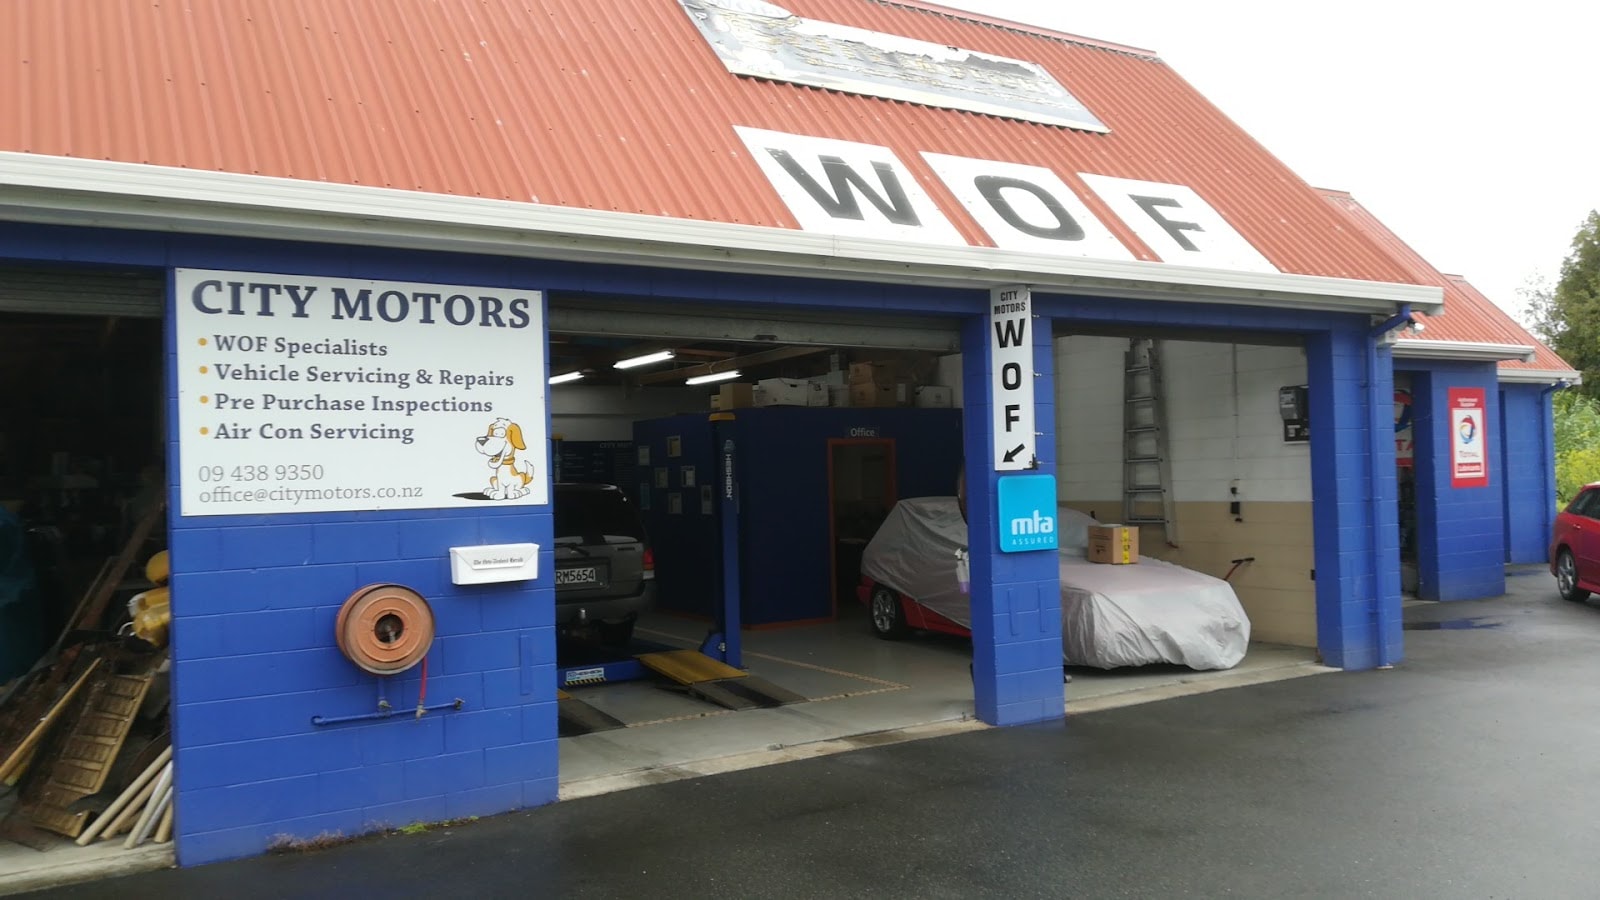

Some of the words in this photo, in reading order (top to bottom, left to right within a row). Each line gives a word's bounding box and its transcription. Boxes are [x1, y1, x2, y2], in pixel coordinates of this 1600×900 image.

[192, 279, 317, 319] CITY
[331, 287, 530, 329] MOTORS
[1000, 291, 1018, 302] CITY
[994, 302, 1026, 315] MOTORS
[213, 335, 268, 352] WOF
[274, 337, 388, 358] Specialists
[213, 363, 300, 381] Vehicle
[306, 366, 410, 389] Servicing
[416, 369, 433, 384] &
[439, 369, 514, 389] Repairs
[994, 318, 1026, 432] WOF
[214, 393, 255, 410] Pre
[262, 394, 365, 411] Purchase
[372, 395, 493, 416] Inspections
[214, 422, 252, 440] Air
[259, 423, 303, 439] Con
[310, 423, 414, 445] Servicing
[850, 427, 875, 437] Office
[198, 465, 224, 482] 09
[230, 465, 269, 481] 438
[275, 464, 324, 481] 9350
[198, 485, 423, 505] office@citymotors.co.nz
[1011, 509, 1054, 536] mta
[1012, 536, 1055, 546] ASSURED
[555, 569, 594, 583] RM5654
